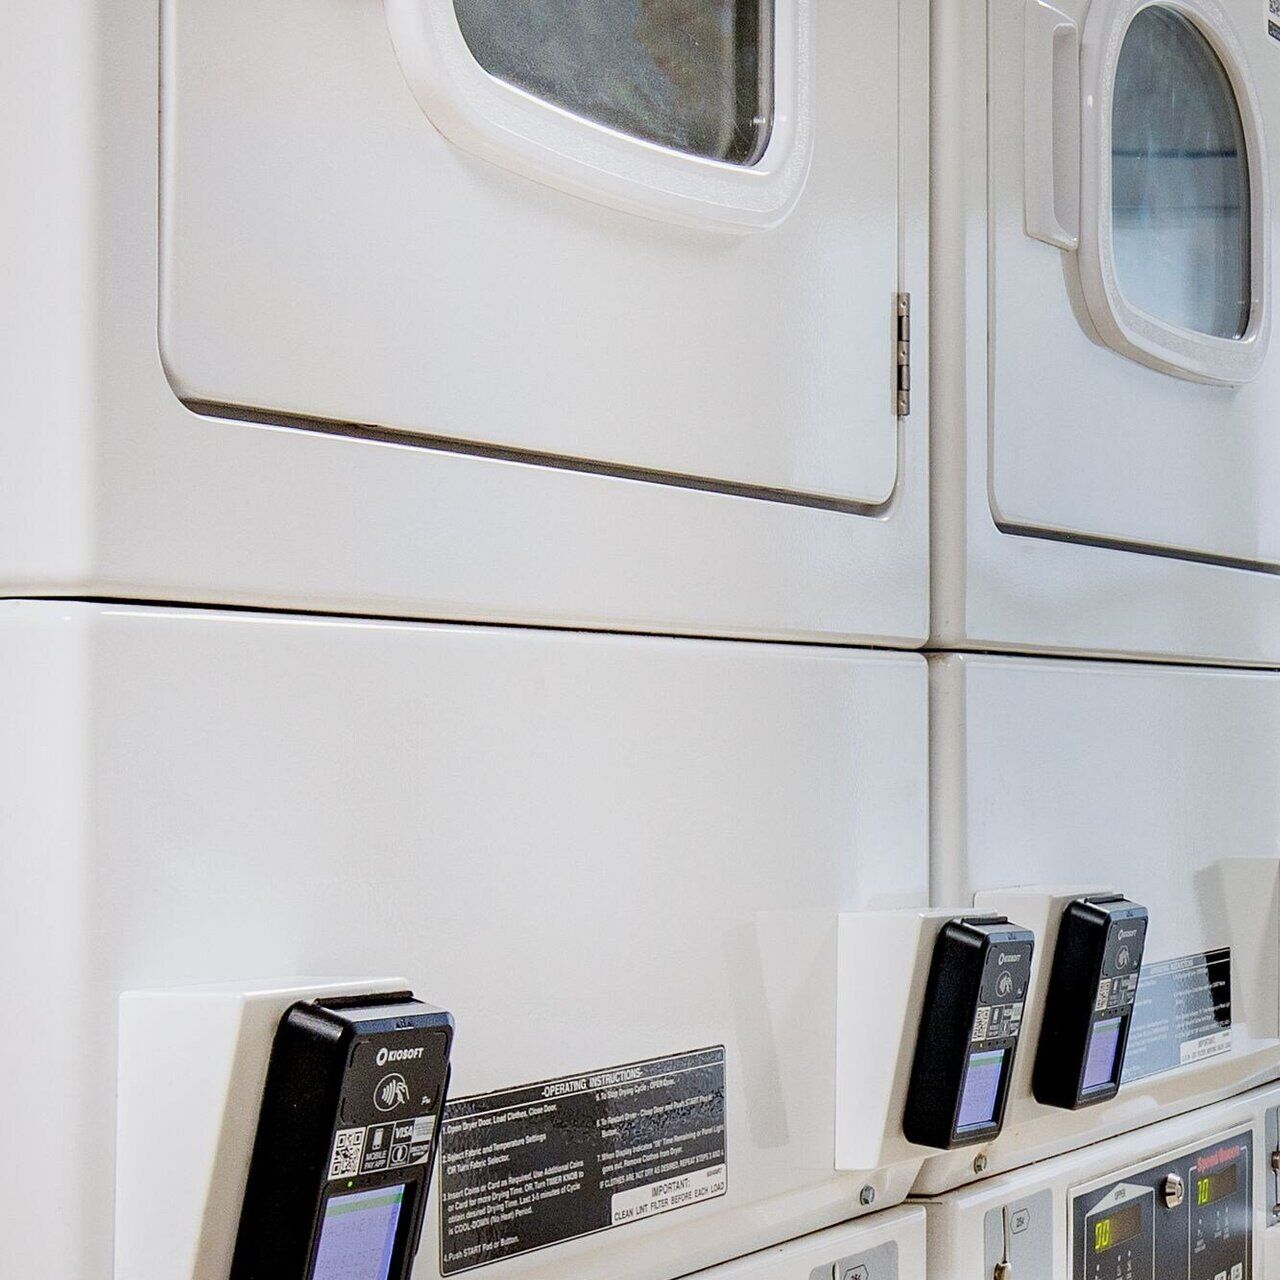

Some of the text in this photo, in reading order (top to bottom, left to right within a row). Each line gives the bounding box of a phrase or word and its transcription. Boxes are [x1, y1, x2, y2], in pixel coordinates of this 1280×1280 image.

[388, 1048, 424, 1062] KIOSOFT
[462, 1119, 477, 1132] Dryer
[493, 1112, 506, 1124] Load
[528, 1105, 542, 1116] Close
[396, 1126, 413, 1139] VISA
[614, 1180, 724, 1222] CLEAN LINT FILTER BEFORE EACH LOAD
[463, 1243, 481, 1257] START
